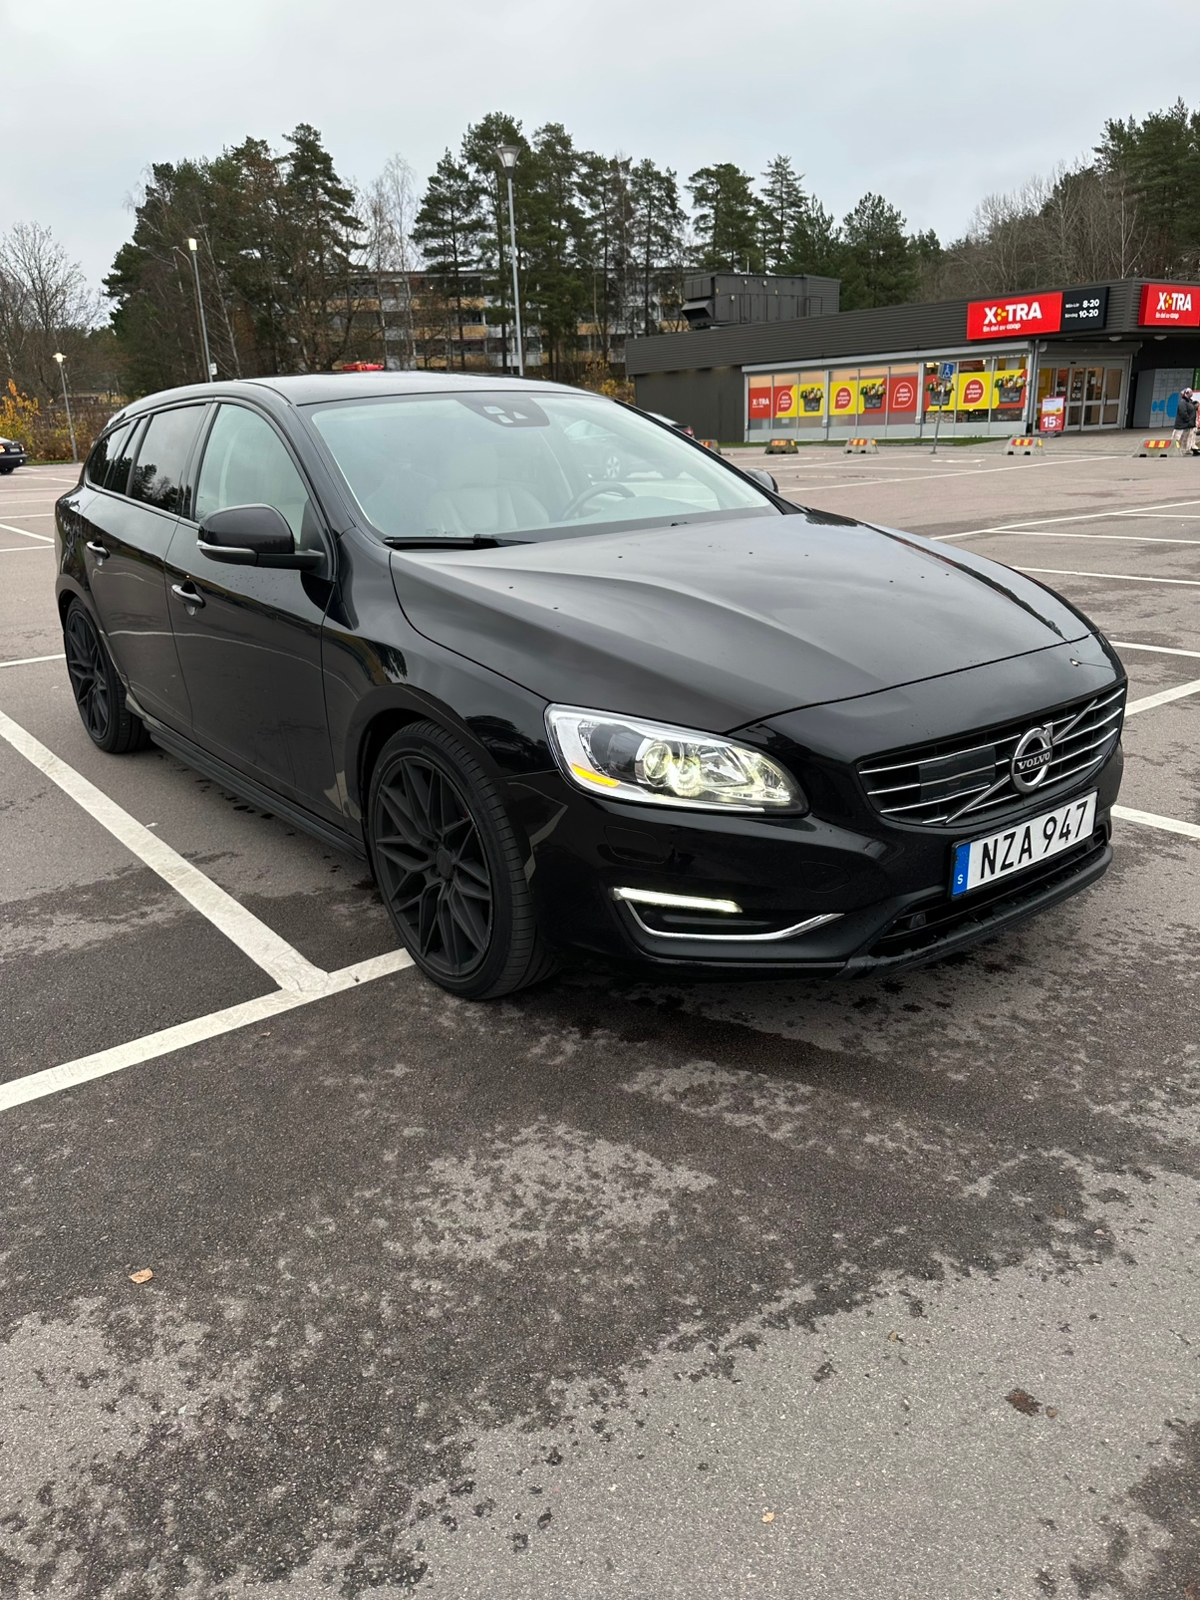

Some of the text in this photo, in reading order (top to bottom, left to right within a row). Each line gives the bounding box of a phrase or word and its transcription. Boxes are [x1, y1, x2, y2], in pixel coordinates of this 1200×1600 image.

[1082, 299, 1100, 308] 8-20
[1079, 309, 1099, 318] 10-20
[1017, 752, 1050, 770] VOLVO
[980, 800, 1088, 880] NZA 947
[957, 874, 963, 885] S
